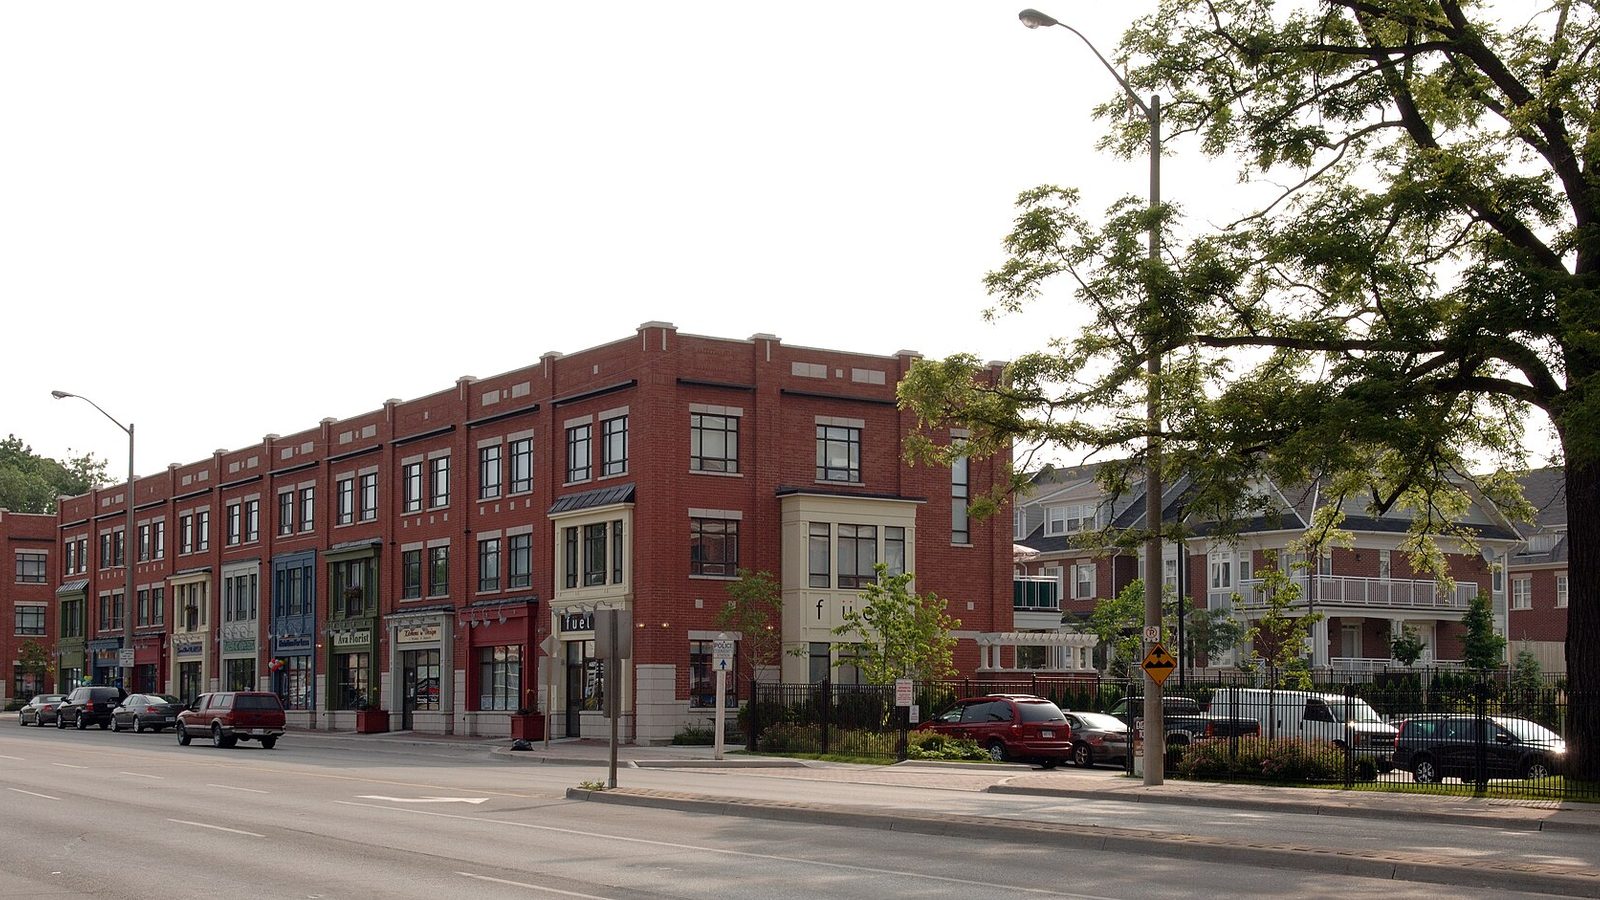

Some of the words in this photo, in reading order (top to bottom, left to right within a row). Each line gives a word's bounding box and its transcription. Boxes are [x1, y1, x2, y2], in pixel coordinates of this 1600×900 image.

[566, 616, 590, 630] fuel
[337, 635, 349, 644] Ava
[350, 633, 369, 644] Florist
